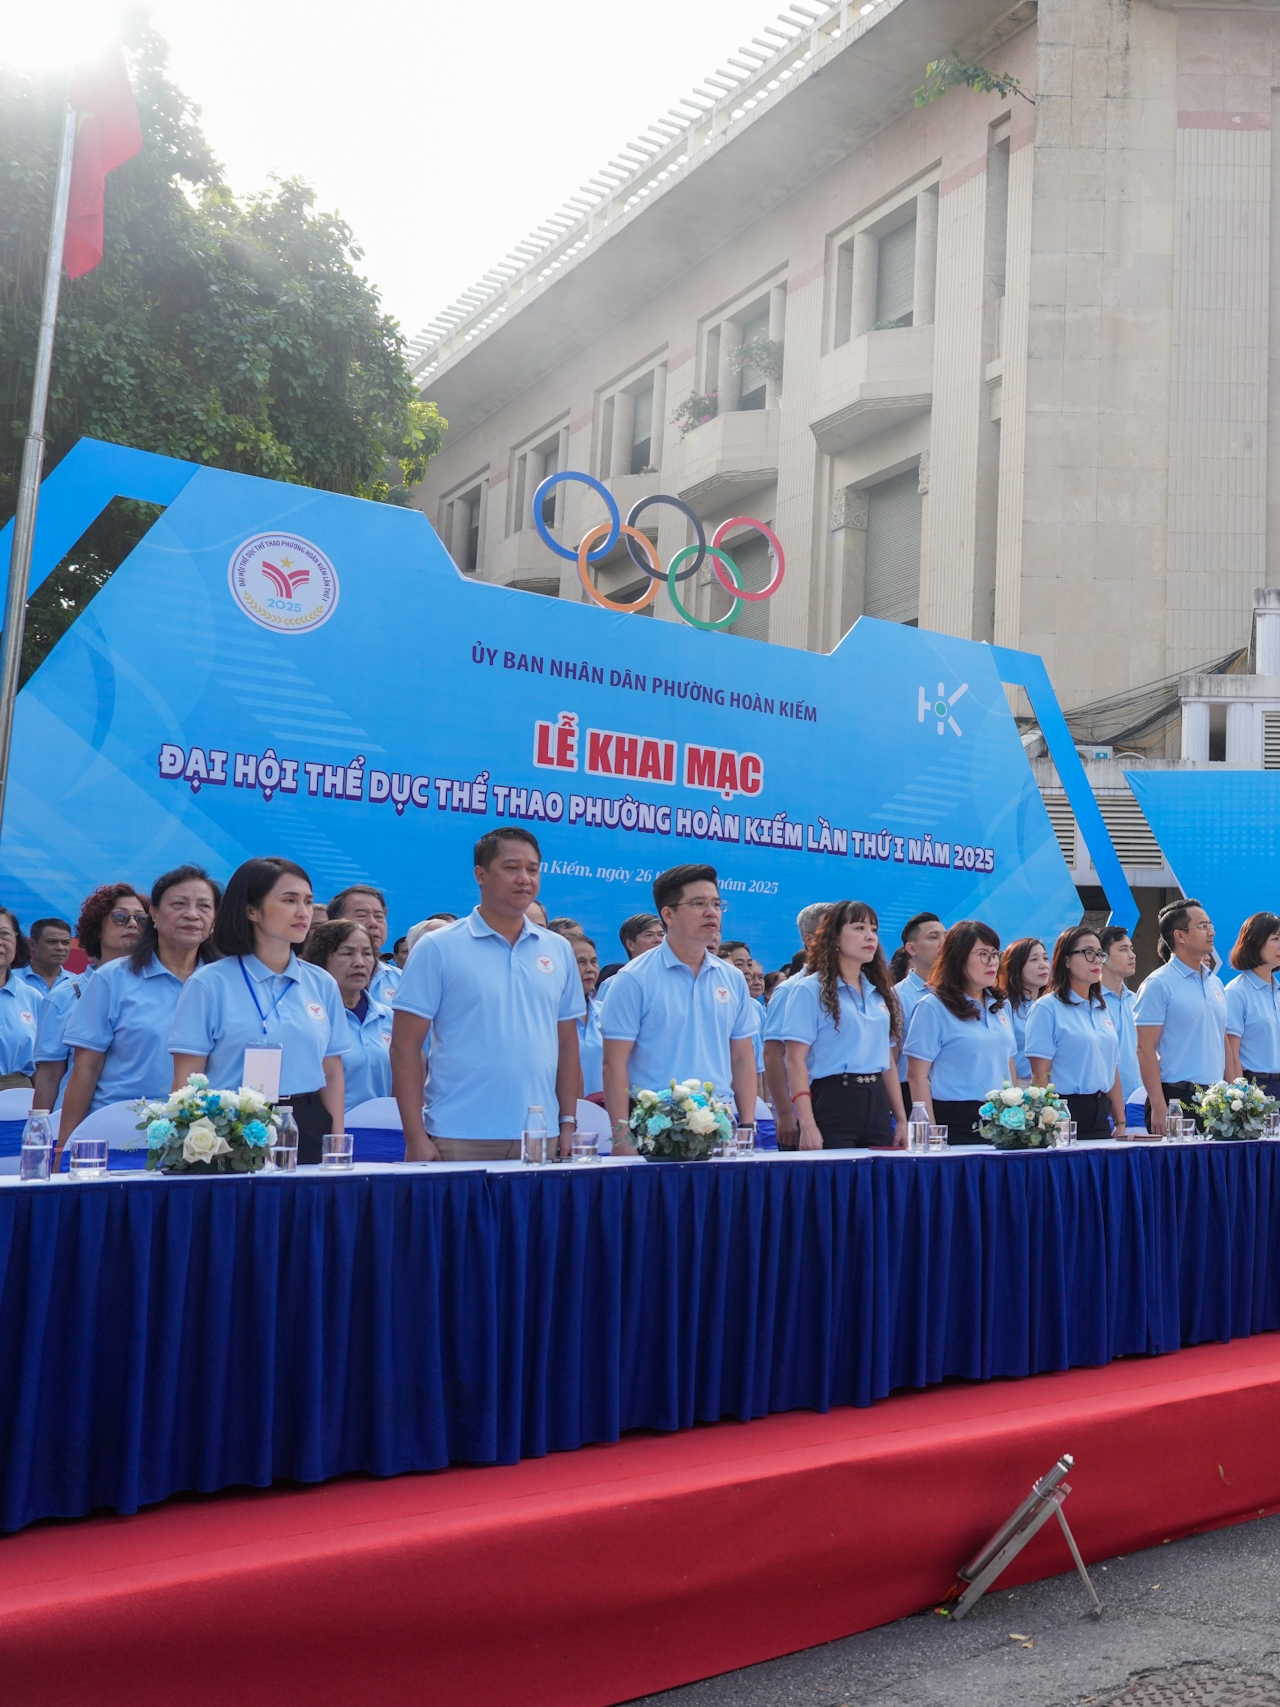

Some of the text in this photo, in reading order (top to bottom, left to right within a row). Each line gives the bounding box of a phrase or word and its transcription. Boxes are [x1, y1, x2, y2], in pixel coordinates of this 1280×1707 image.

[267, 598, 302, 612] 2025
[472, 641, 817, 722] ỦY BAN NHÂN DÂN PHƯỜNG HOÀN KIẾM
[536, 714, 762, 798] LỄ KHAI MẠC
[159, 744, 994, 874] ĐẠI HỘI THỂ DỤC THỂ THAO PHƯỜNG HOÀN KIẾM LẦN THỨ I NĂM 2025
[550, 860, 594, 878] Kiếm,
[596, 866, 634, 883] ngày
[635, 869, 652, 882] 26
[717, 878, 779, 895] năm 2025
